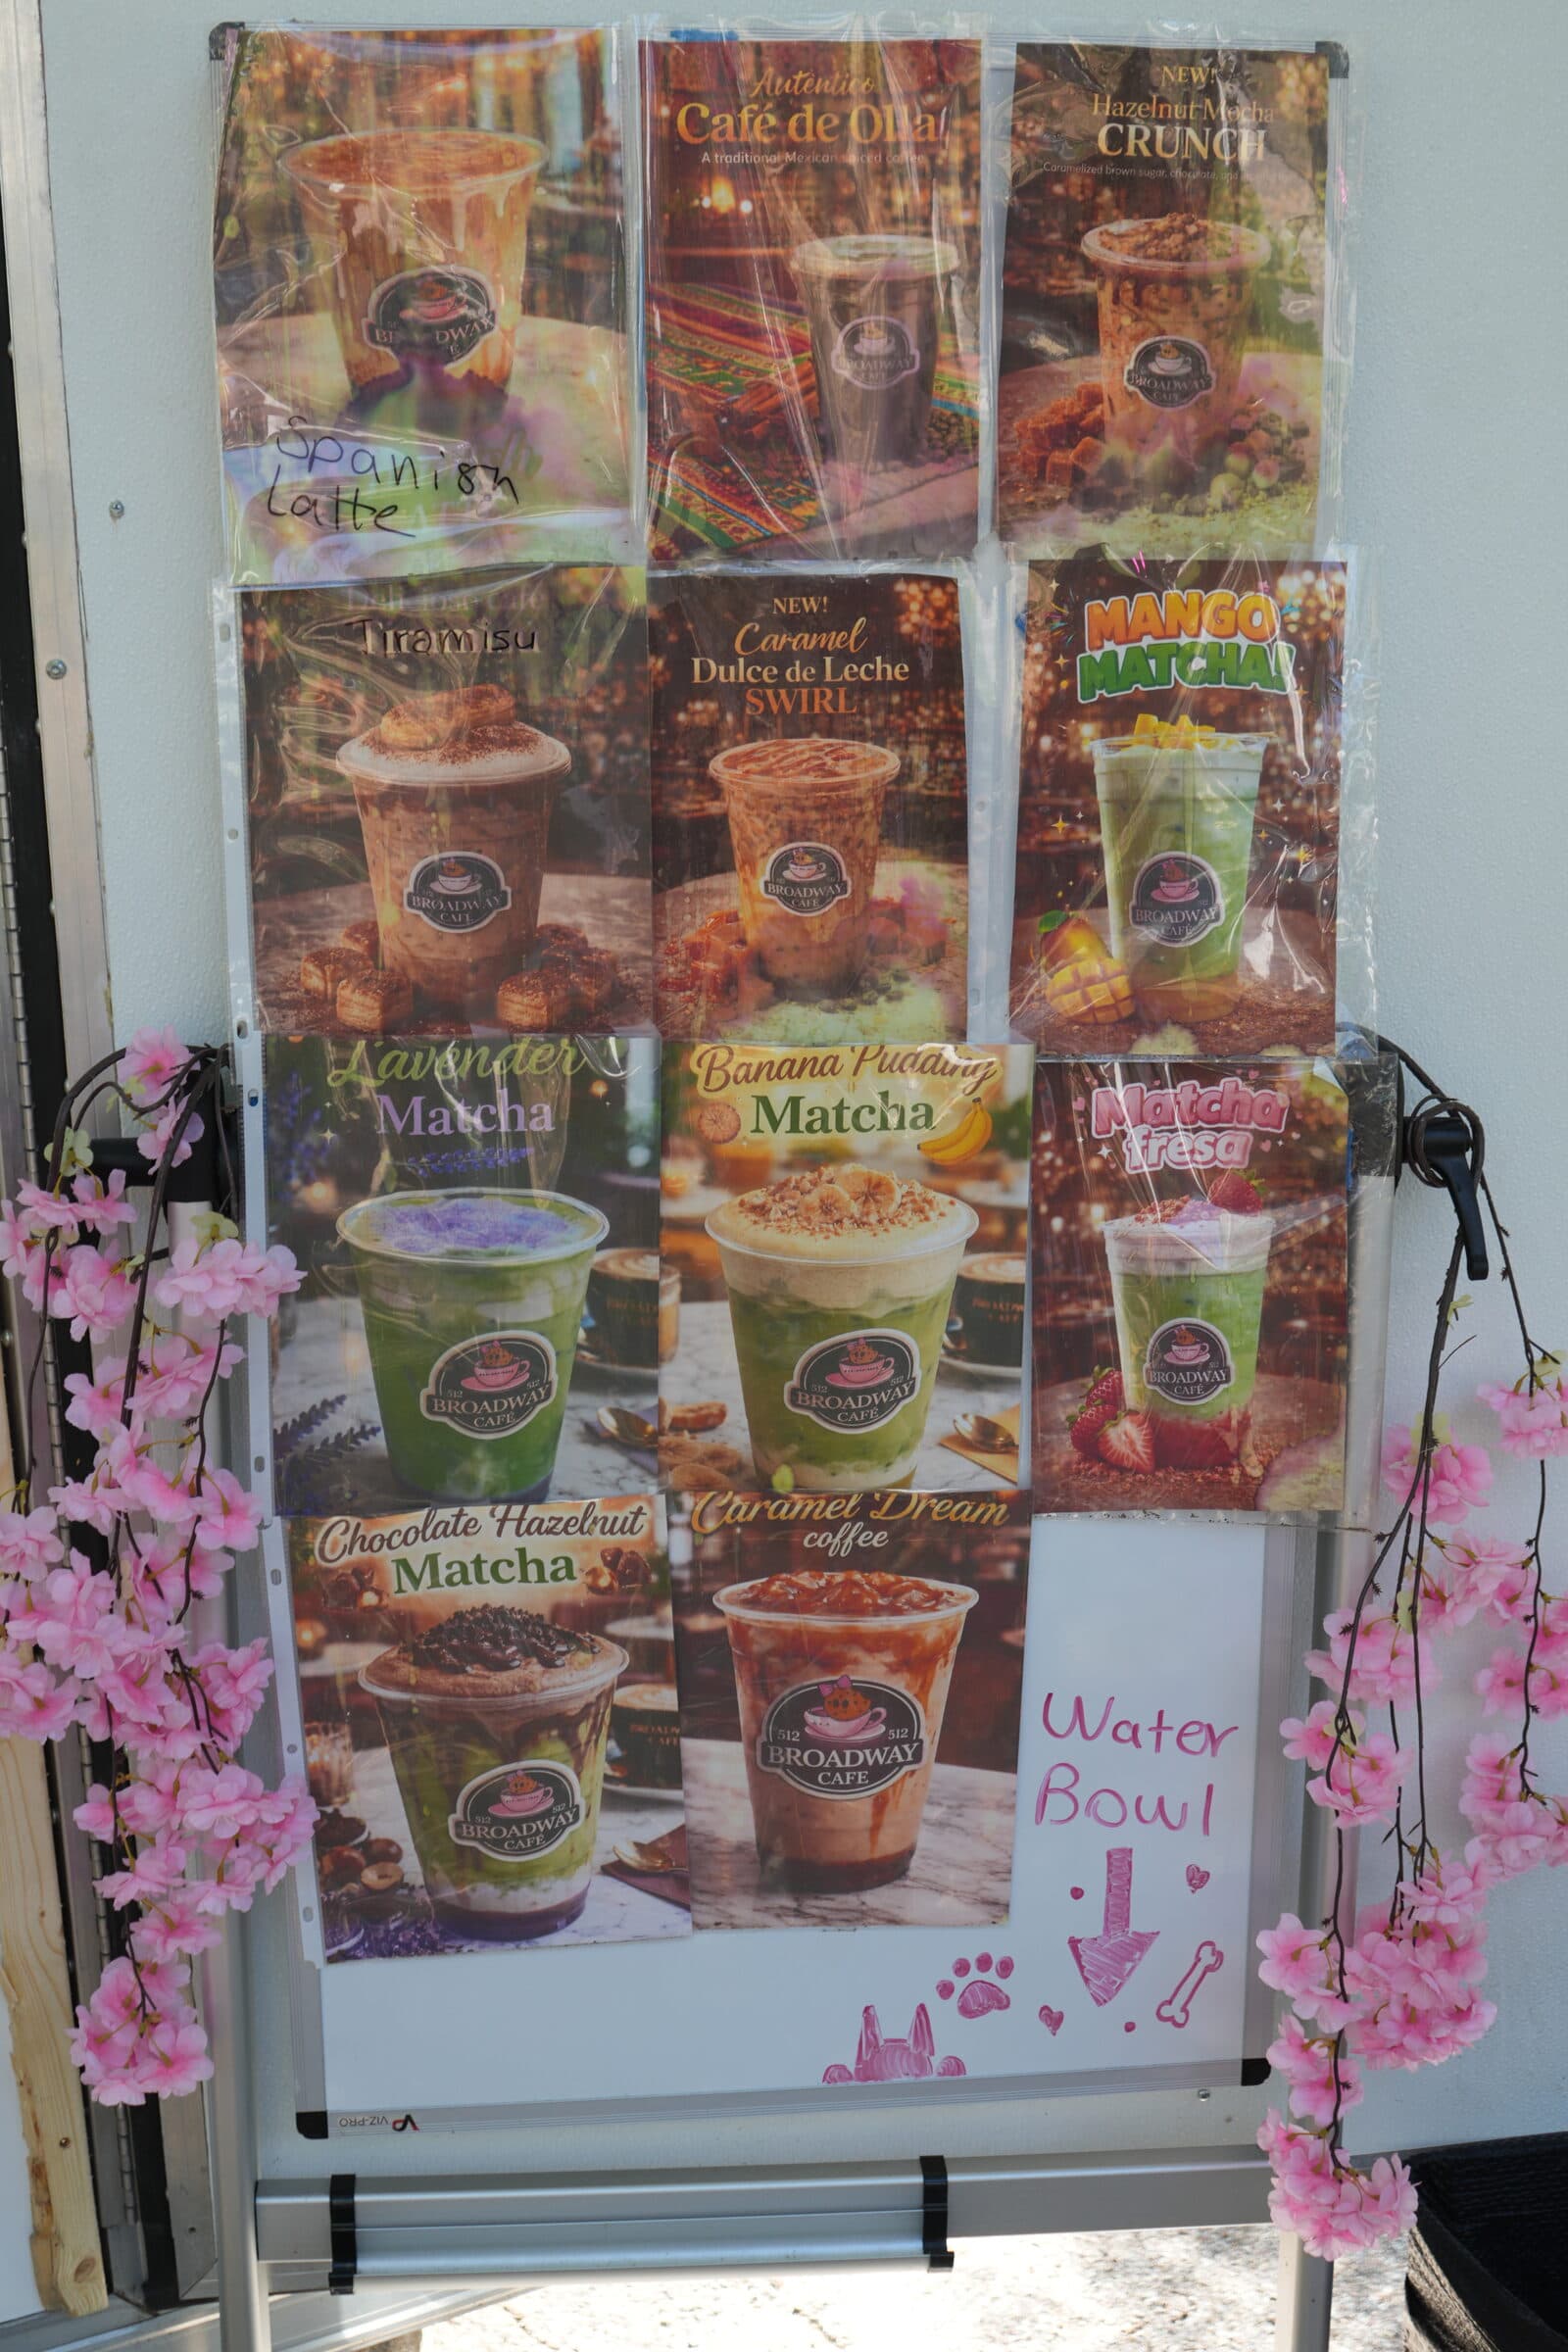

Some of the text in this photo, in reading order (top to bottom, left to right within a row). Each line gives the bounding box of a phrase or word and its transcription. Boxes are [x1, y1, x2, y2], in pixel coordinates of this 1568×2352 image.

[1161, 66, 1217, 86] NEW!
[676, 102, 940, 145] Café de Olla
[1092, 93, 1274, 122] Hazelnut Mocha
[702, 152, 710, 164] A
[1098, 122, 1267, 162] CRUNCH
[1105, 164, 1137, 177] brown
[276, 416, 520, 506] Spanish
[267, 464, 416, 538] Latte
[772, 596, 828, 614] NEW!
[1085, 589, 1281, 652] MANGO
[346, 619, 542, 658] Tiramisu
[734, 616, 868, 656] Caramel
[691, 656, 909, 684] Dulce de Leche
[745, 687, 858, 715] SWIRL
[412, 893, 502, 911] BROADWAY
[767, 883, 843, 898] BROADWAY
[1136, 906, 1217, 923] BROADWAY
[326, 1037, 590, 1088] Lavender
[696, 1044, 998, 1097] Banana Pudding
[376, 1088, 557, 1136] Matcha
[751, 1090, 938, 1135] Matcha
[1093, 1077, 1291, 1139] Matcha
[1122, 1125, 1253, 1175] fresa
[1150, 1369, 1227, 1384] BROADWAY
[432, 1384, 550, 1414] BROADWAY
[797, 1379, 915, 1409] BROADWAY
[691, 1491, 1010, 1534] Caramel Dream
[317, 1500, 648, 1564] Chocolate Hazelnut
[803, 1522, 889, 1557] coffee
[391, 1547, 577, 1594] Matcha
[777, 1729, 801, 1742] 512
[887, 1727, 909, 1740] 512
[1042, 1691, 1240, 1758] Water
[767, 1741, 920, 1768] BROADWAY
[817, 1771, 869, 1786] CAFE
[1035, 1762, 1214, 1837] Bowl
[462, 1808, 577, 1838] BROADWAY
[338, 2116, 389, 2128] VIZ-PRO
